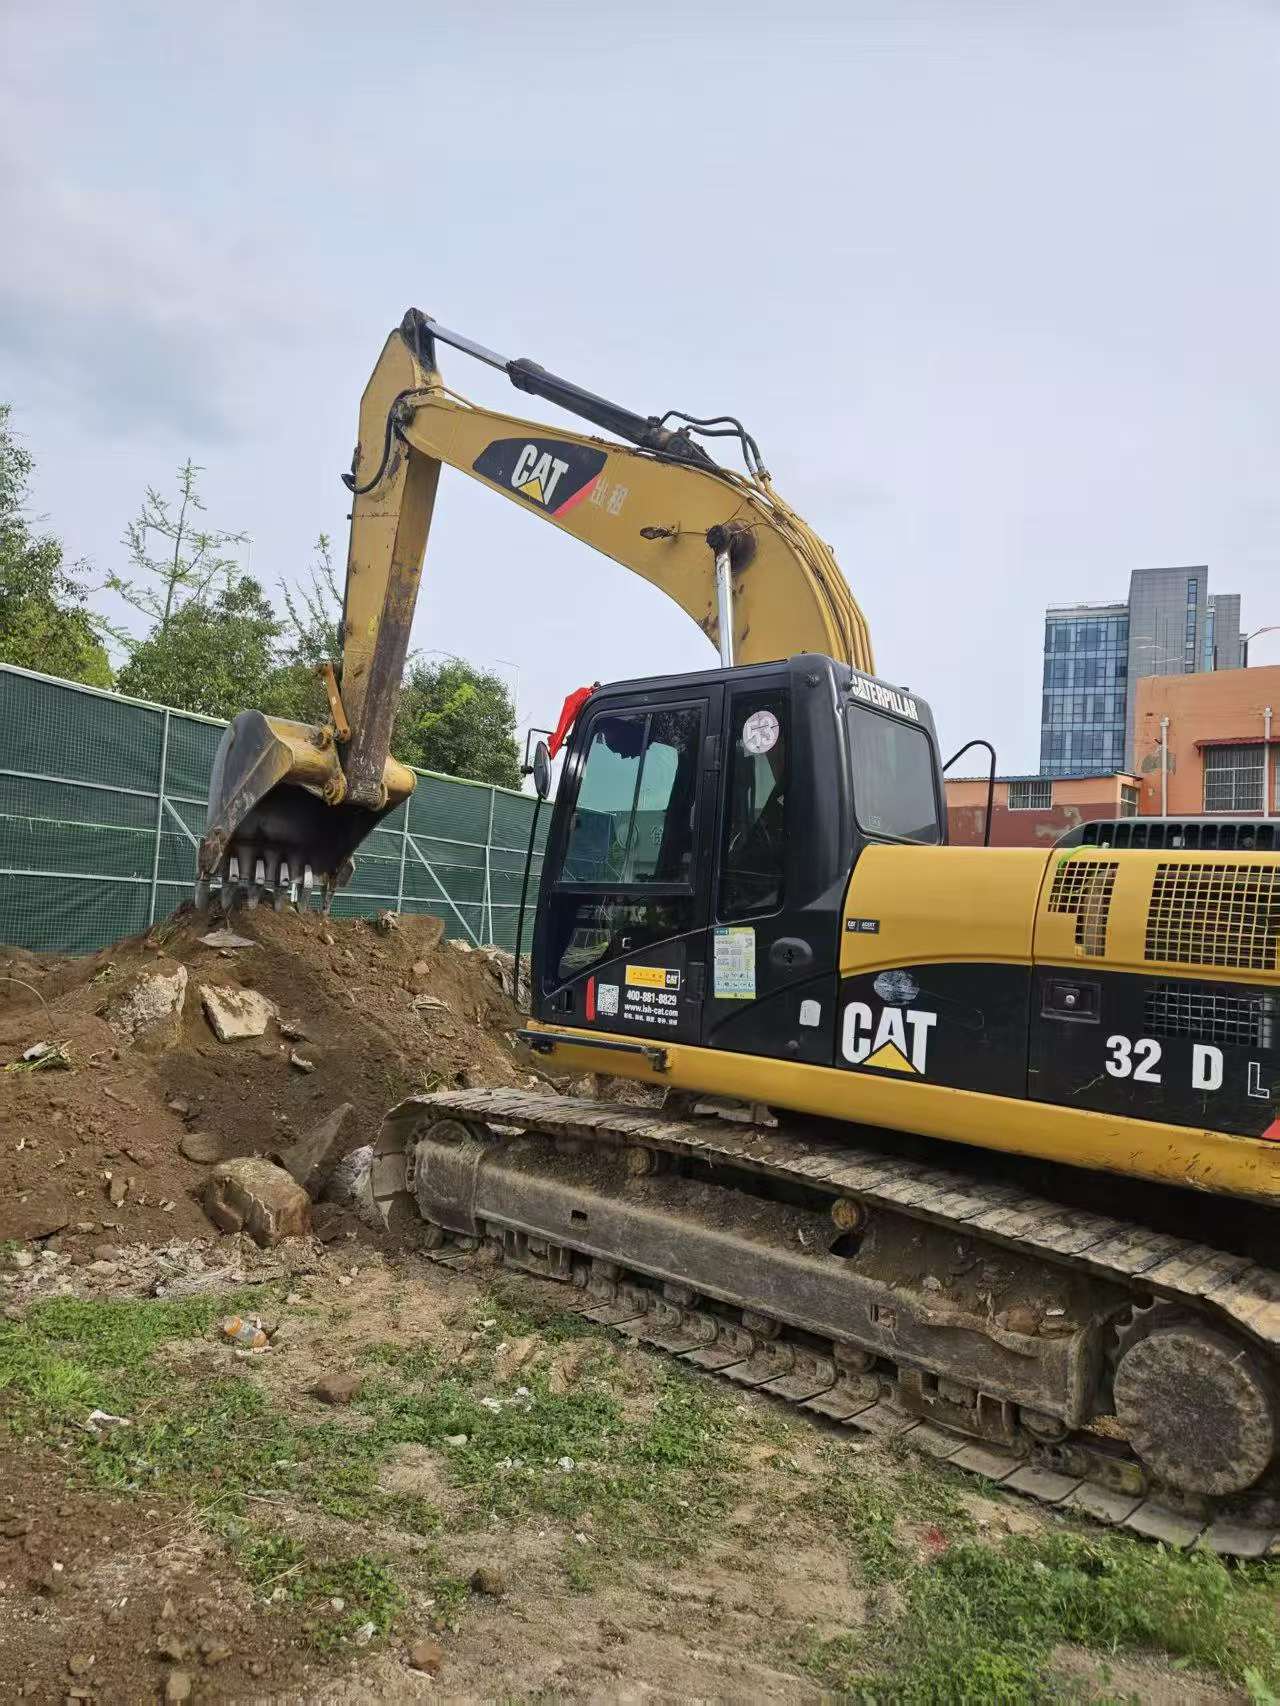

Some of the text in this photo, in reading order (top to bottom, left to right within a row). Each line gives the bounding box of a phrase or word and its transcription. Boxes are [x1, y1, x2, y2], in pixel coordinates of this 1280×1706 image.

[511, 444, 570, 505] CAT
[850, 674, 919, 721] CATERPILLAR
[842, 1001, 938, 1075] CAT
[1105, 1034, 1163, 1084] 32
[1192, 1043, 1224, 1091] D
